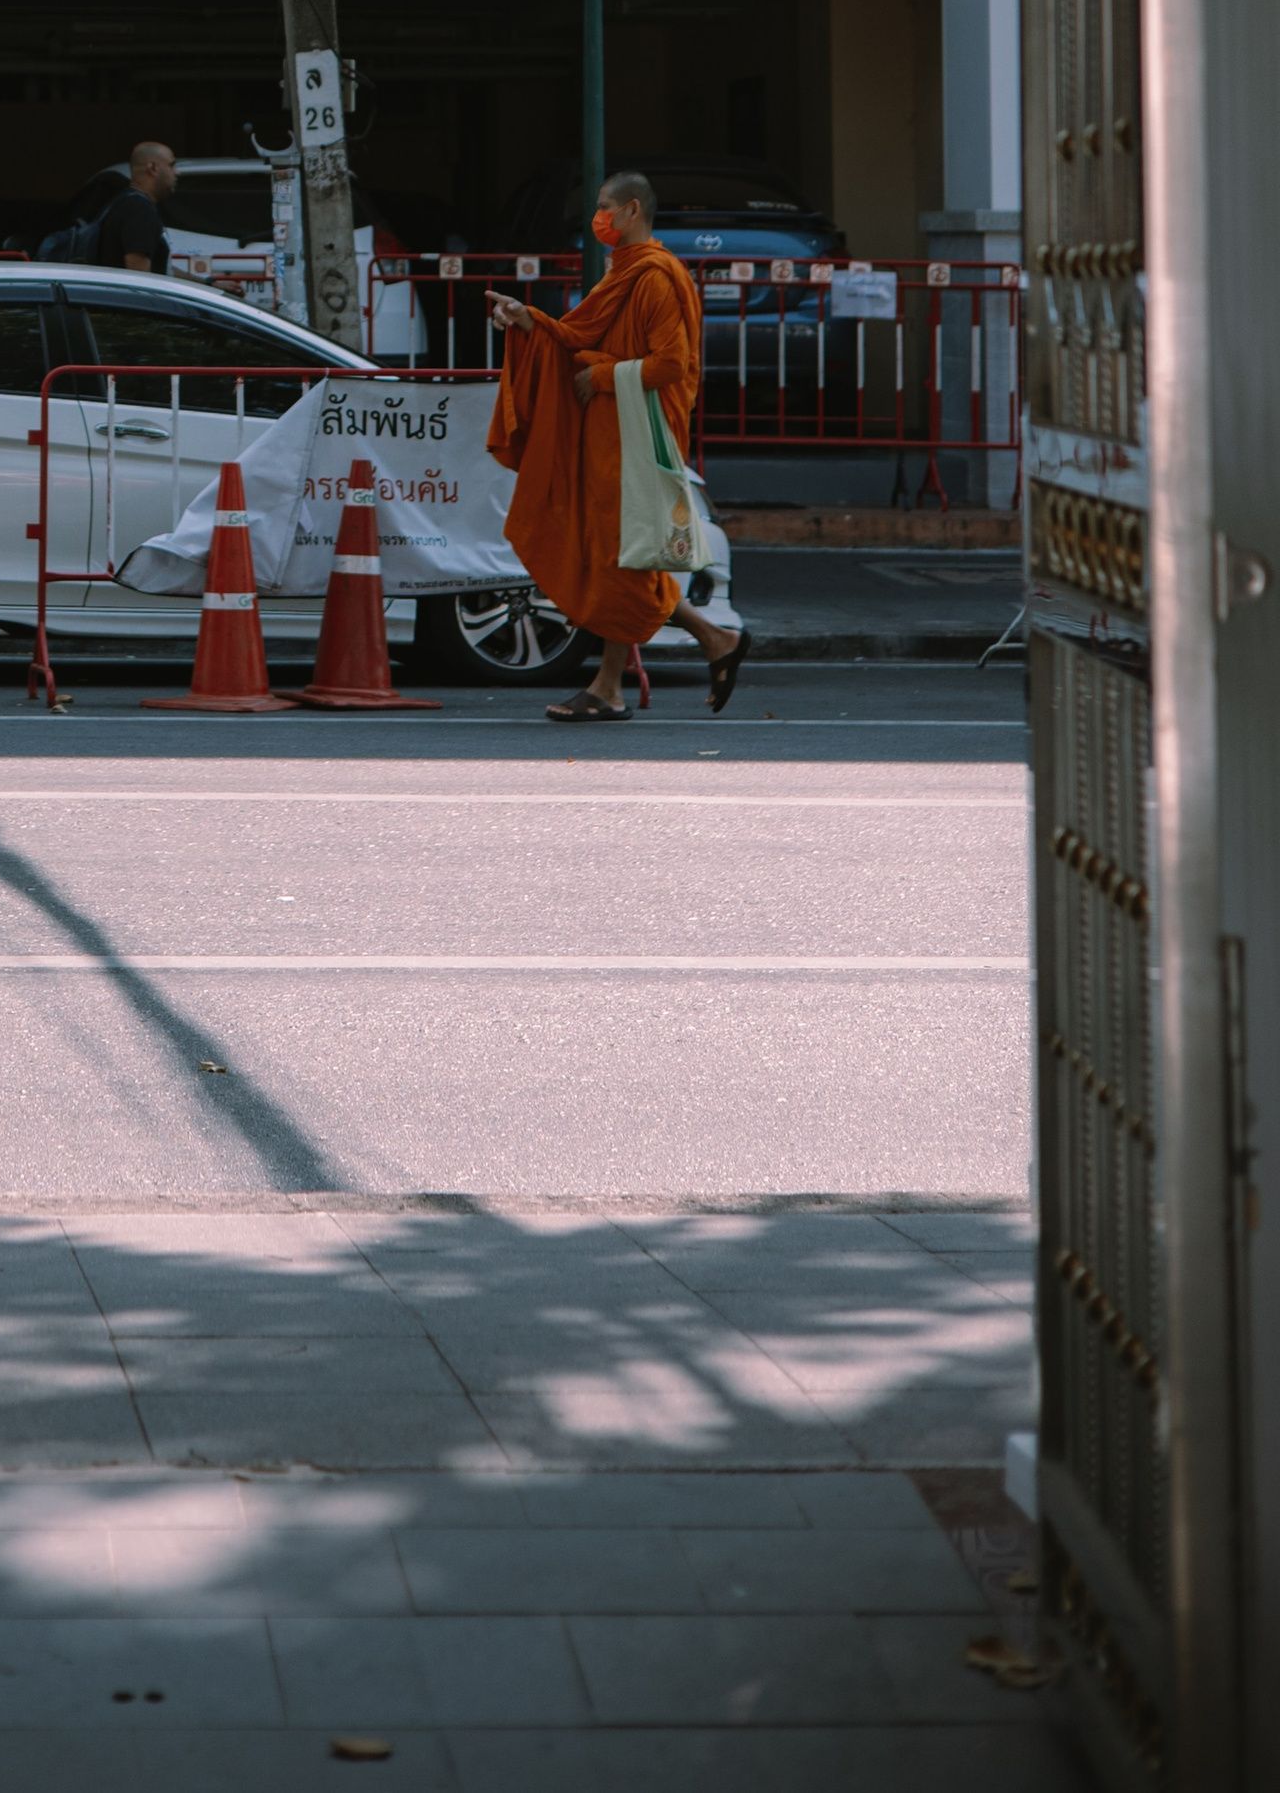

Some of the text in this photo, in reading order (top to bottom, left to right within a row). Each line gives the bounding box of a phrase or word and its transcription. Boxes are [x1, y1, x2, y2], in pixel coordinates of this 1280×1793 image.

[305, 106, 336, 130] 26
[320, 393, 450, 441] สัมพันธ์
